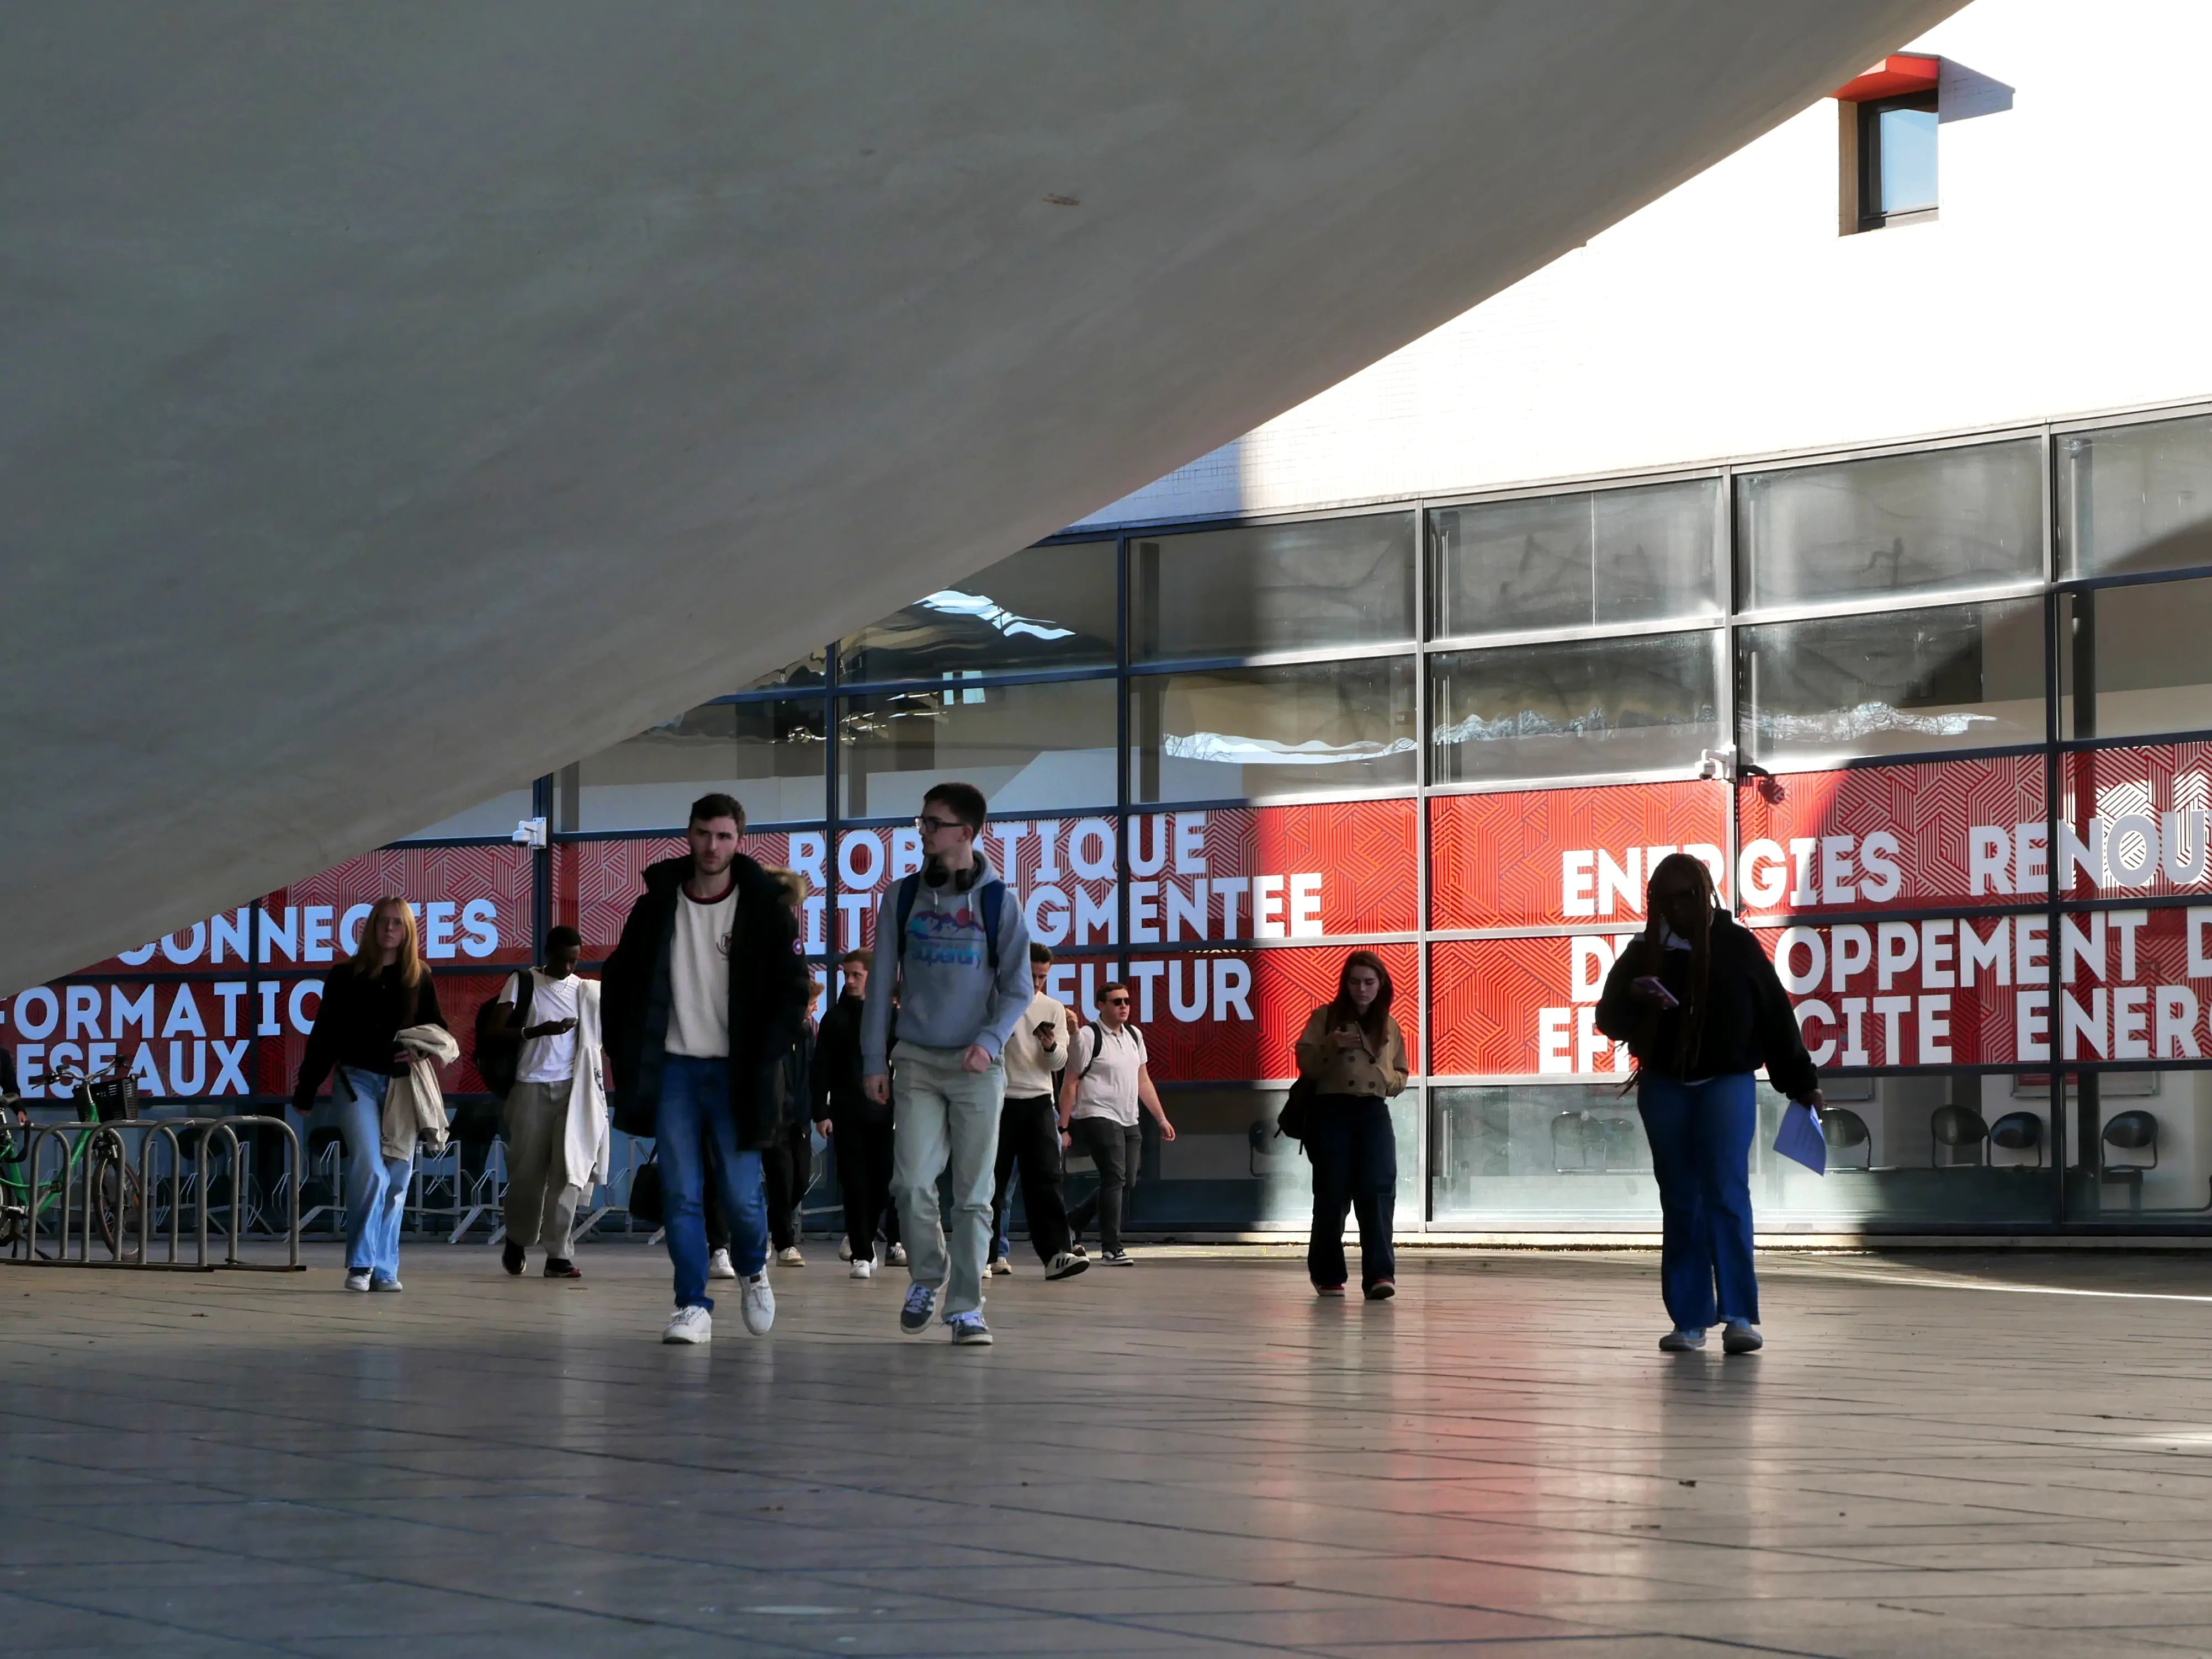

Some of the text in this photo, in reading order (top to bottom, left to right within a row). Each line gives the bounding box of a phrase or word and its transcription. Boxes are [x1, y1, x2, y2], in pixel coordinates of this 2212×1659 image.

[789, 812, 1206, 890] ROBTIQUE
[1970, 810, 2212, 895] RENOU
[117, 899, 498, 965] ONNECES
[1011, 873, 1323, 948] GMENTEE
[0, 980, 322, 1040] ORMATIO
[1047, 959, 1254, 1023] FUTUR
[2017, 986, 2212, 1061] ENER
